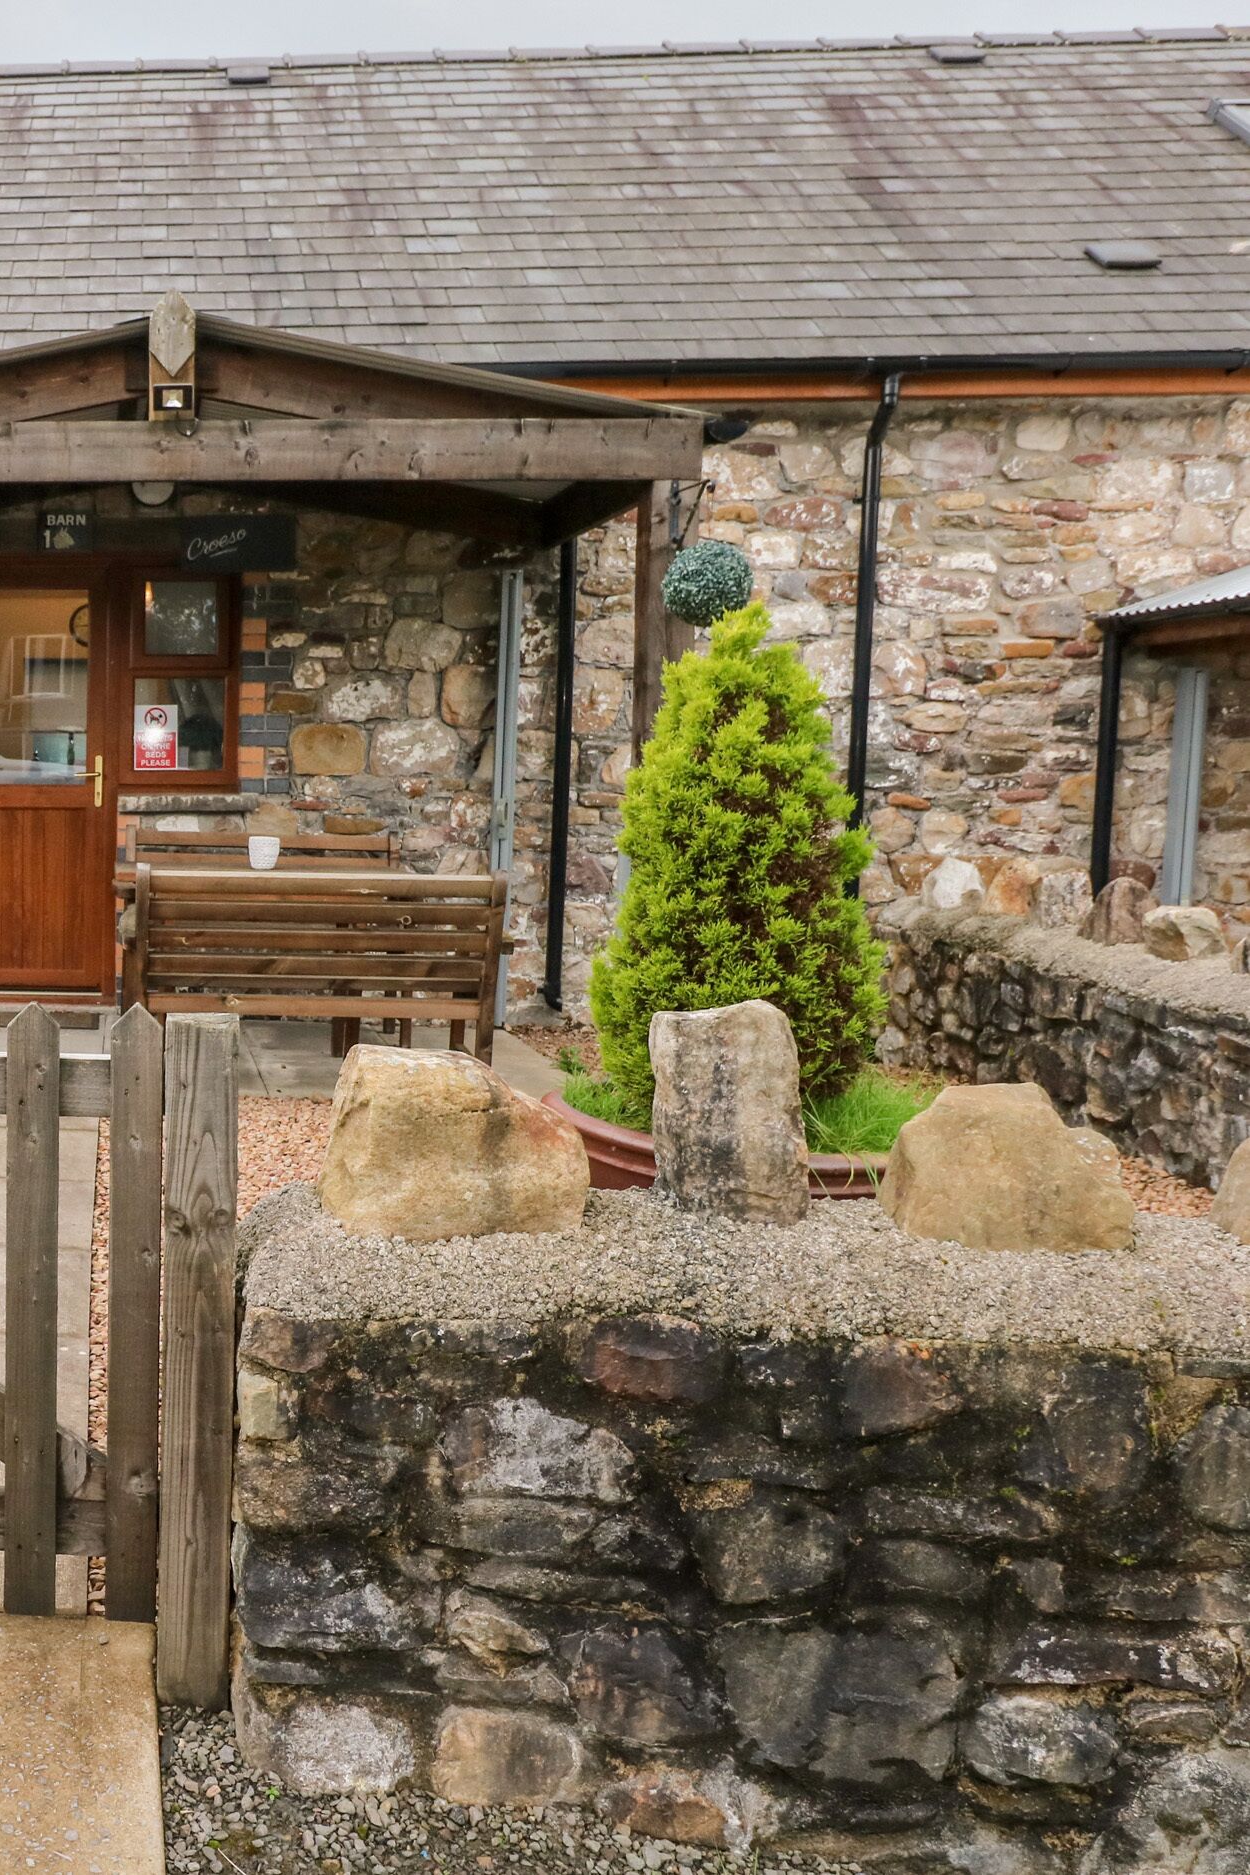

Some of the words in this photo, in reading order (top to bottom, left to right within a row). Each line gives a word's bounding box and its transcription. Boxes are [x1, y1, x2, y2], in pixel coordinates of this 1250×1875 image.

[47, 514, 86, 526] BARN
[43, 529, 51, 549] 1
[187, 528, 246, 560] Croeso
[145, 750, 167, 758] BEDS
[140, 759, 171, 767] PLEASE
